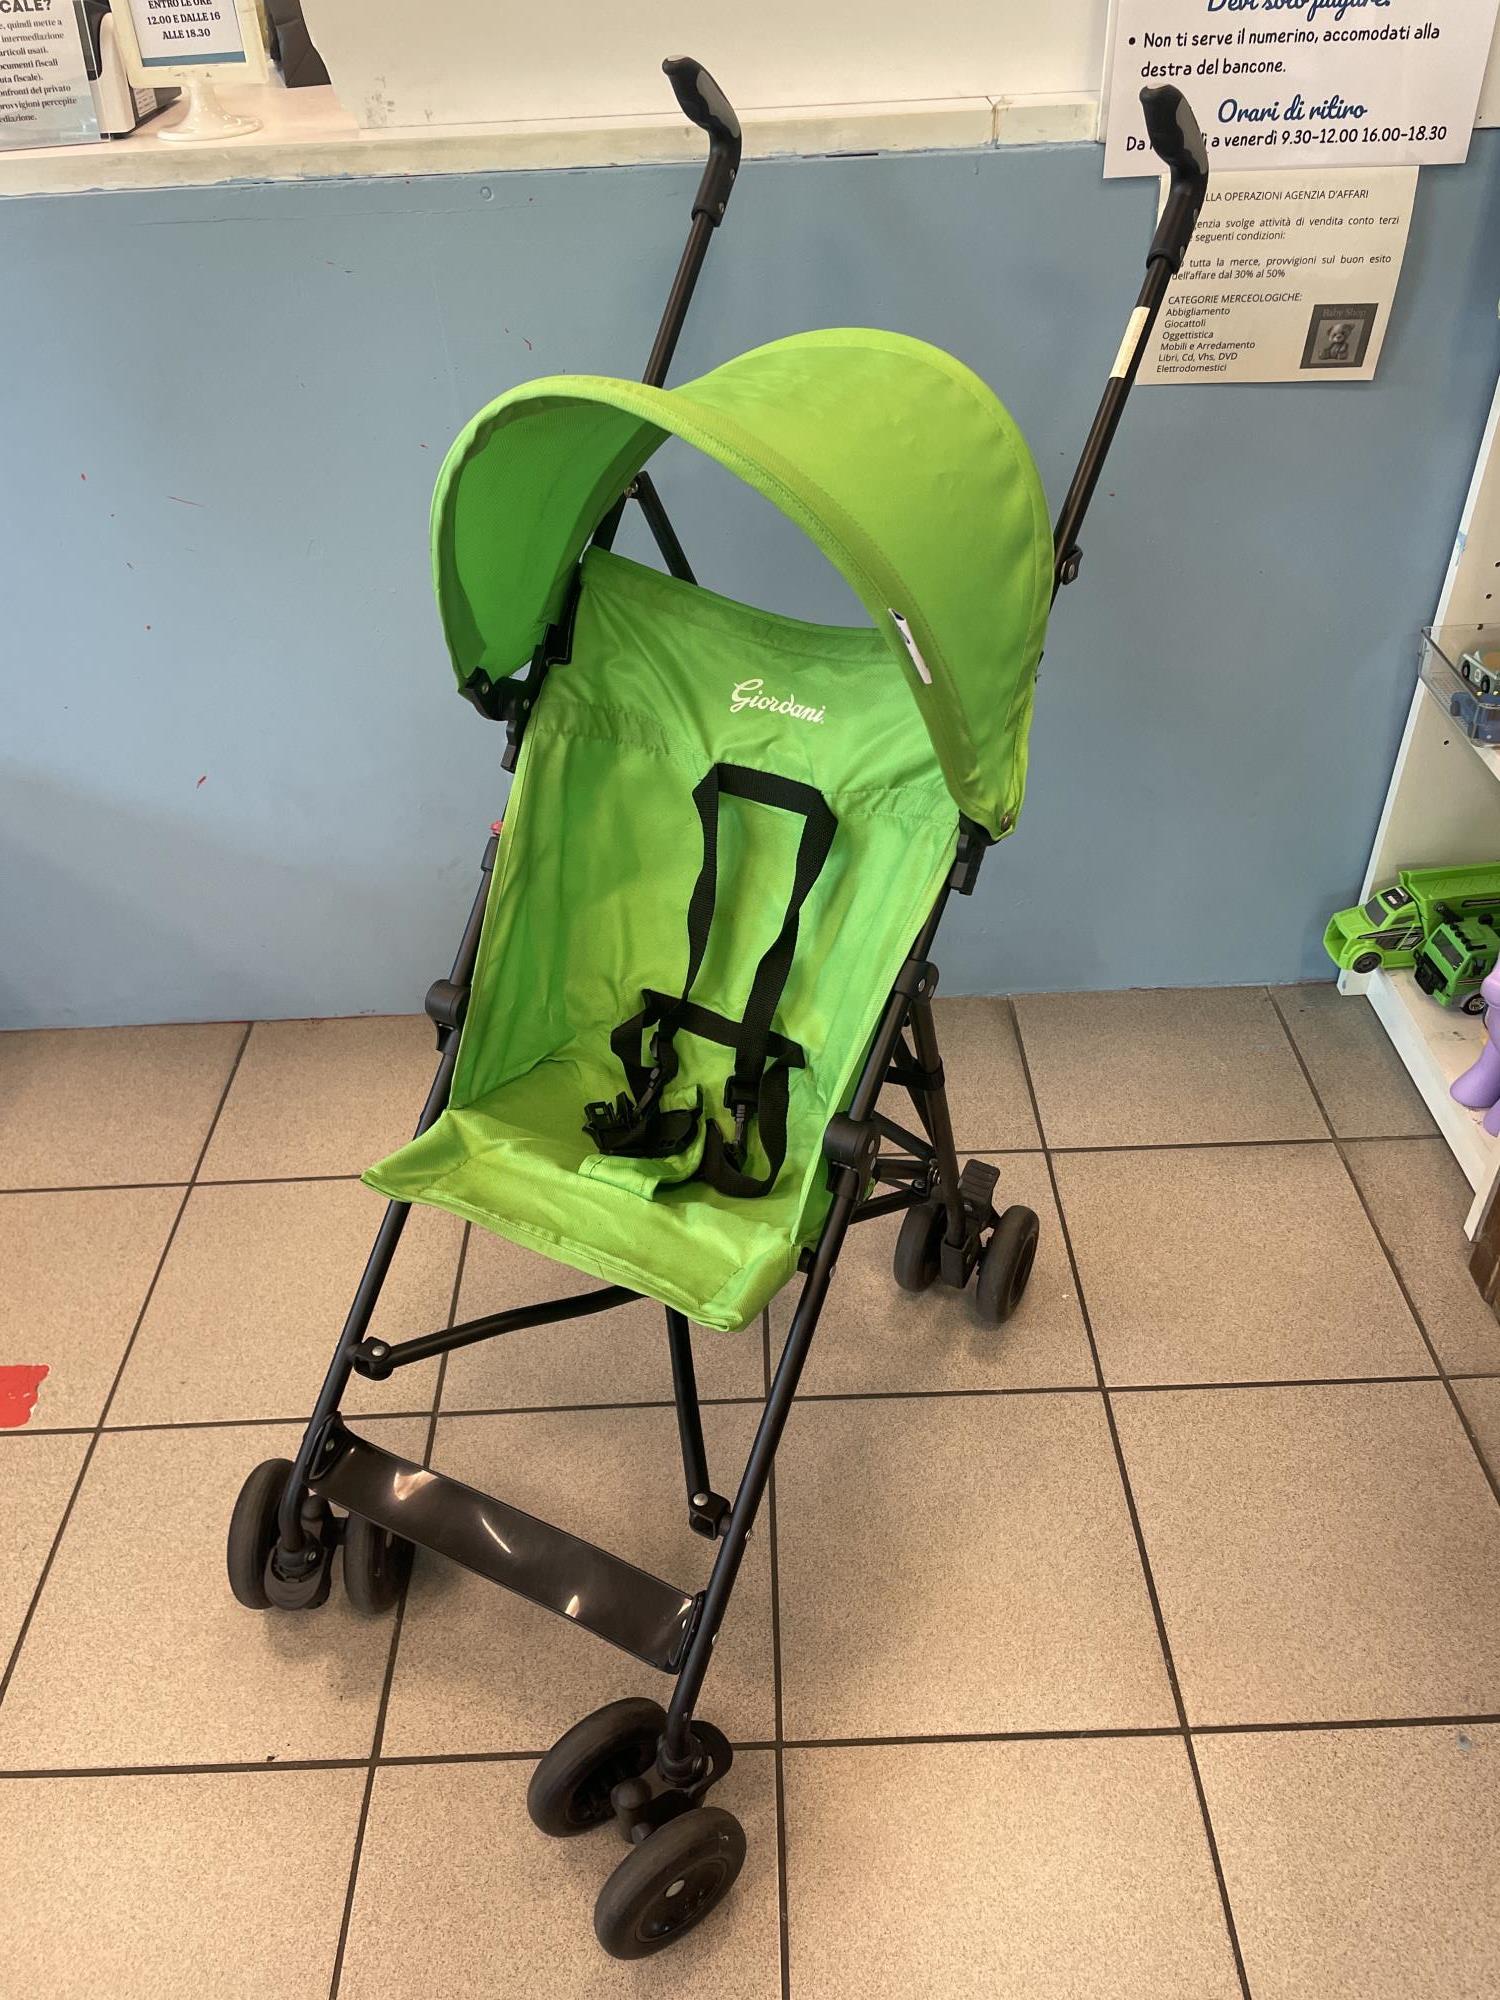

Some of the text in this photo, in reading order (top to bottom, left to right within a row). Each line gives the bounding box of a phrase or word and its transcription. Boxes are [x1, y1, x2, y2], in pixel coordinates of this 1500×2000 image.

[148, 0, 180, 9] ENTRO
[147, 11, 221, 25] 12.00 E DALLE 16
[7, 20, 32, 31] quindi
[1, 32, 65, 42] intermediazione
[163, 28, 211, 40] ALLE 18.30
[1143, 22, 1440, 48] Non ti serve il numerino, accomodati alla
[27, 47, 49, 55] usati.
[35, 58, 58, 67] fiscali
[1140, 57, 1287, 77] destra del bancone.
[13, 73, 43, 82] fiscale).
[30, 86, 43, 95] del
[43, 84, 72, 95] privato
[41, 97, 78, 109] percepite
[1217, 93, 1368, 123] Orari di ritiro
[1126, 136, 1146, 151] Da
[1211, 137, 1220, 148] a
[1224, 130, 1278, 147] venerdì
[1281, 128, 1358, 145] 9.30-12.00
[1361, 125, 1448, 143] 16.00-18.30
[1224, 191, 1282, 201] OPERAZIONI
[1285, 190, 1326, 200] AGENZIA
[1328, 190, 1369, 199] D'AFFARI
[1225, 218, 1255, 229] svolge
[1259, 217, 1291, 227] attività
[1295, 217, 1304, 226] di
[1309, 217, 1343, 226] vendita
[1348, 217, 1375, 225] conto
[1379, 216, 1400, 224] terzi
[1195, 232, 1234, 243] seguenti
[1236, 231, 1286, 241] condizioni:
[1190, 259, 1211, 267] tutta
[1216, 258, 1225, 266] la
[1230, 259, 1260, 267] merce,
[1266, 255, 1317, 267] provvigioni
[1322, 255, 1336, 264] sul
[1340, 255, 1364, 264] buon
[1369, 254, 1392, 263] esito
[1218, 270, 1233, 279] dal
[1234, 269, 1254, 278] 30%
[1256, 269, 1264, 278] al
[1266, 269, 1286, 278] 50%
[1168, 292, 1303, 305] CATEGORIE MERCEOLOGICHE:
[1165, 307, 1231, 318] Abbigliamento
[1164, 319, 1206, 328] Giocattoli
[1162, 330, 1214, 341] Oggettistica
[1160, 342, 1188, 351] Mobili
[1196, 341, 1256, 350] Arredamento
[1158, 353, 1179, 362] Libri,
[1181, 353, 1195, 362] Cd,
[1218, 352, 1238, 361] DVD
[1156, 364, 1227, 373] Elettrodomestici
[730, 678, 826, 723] Giordani
